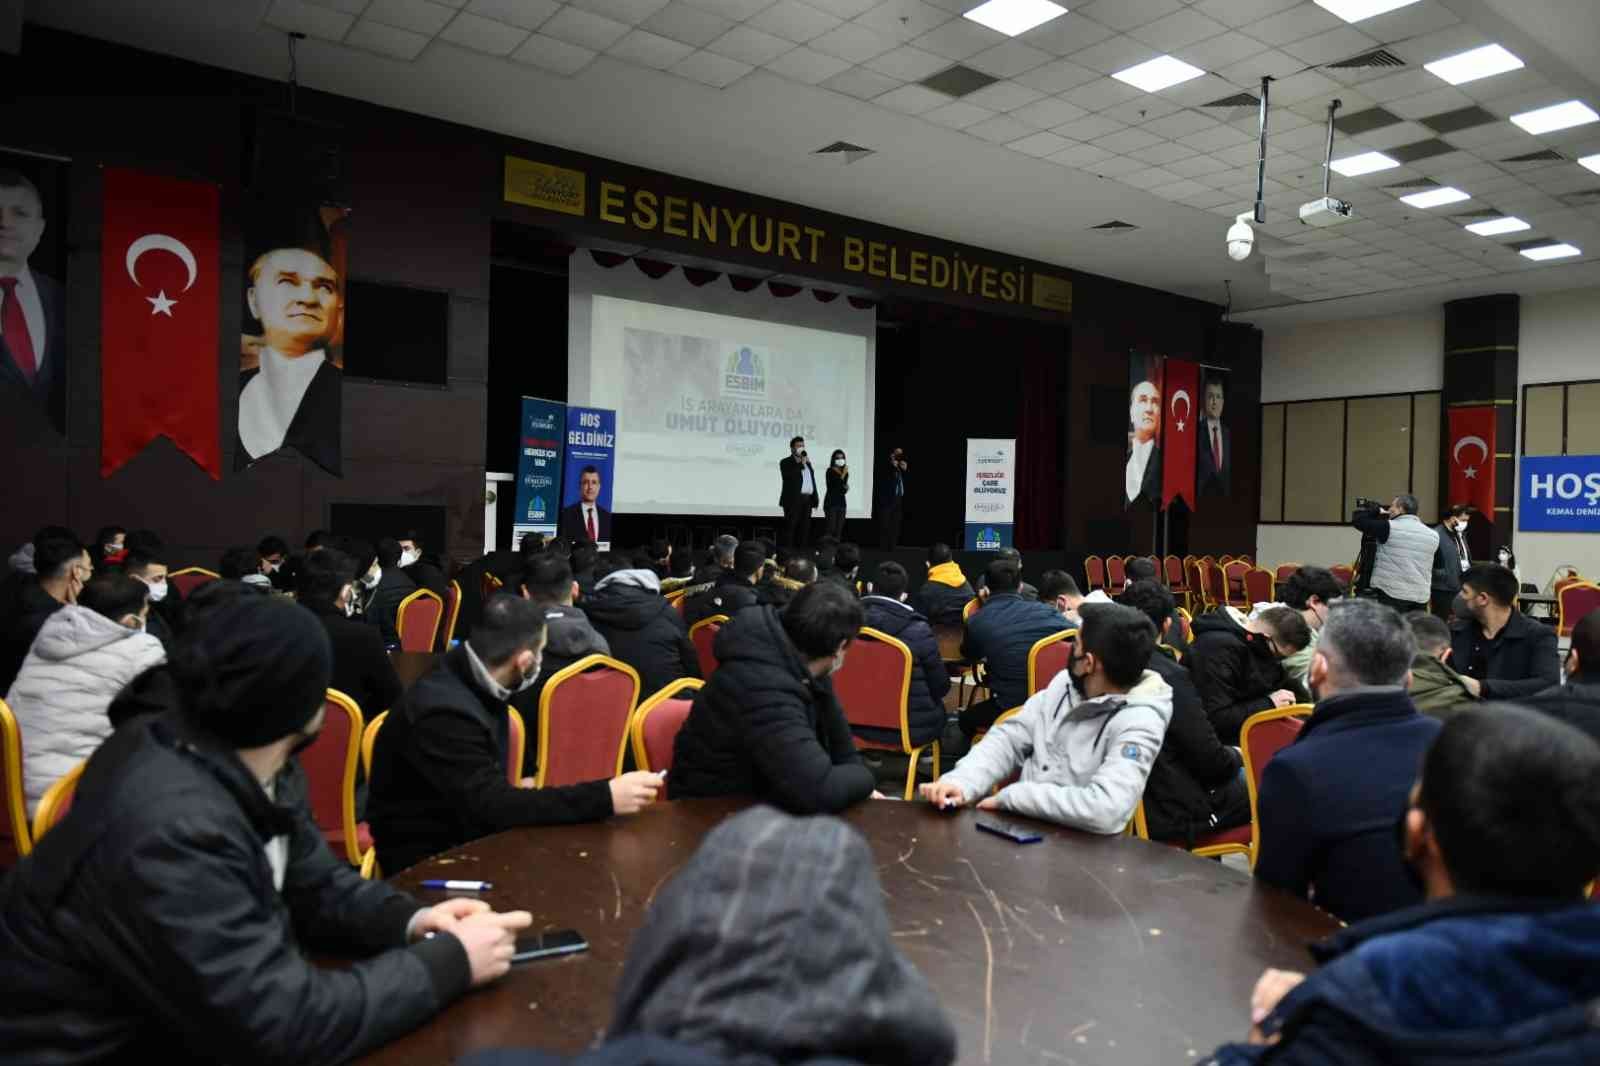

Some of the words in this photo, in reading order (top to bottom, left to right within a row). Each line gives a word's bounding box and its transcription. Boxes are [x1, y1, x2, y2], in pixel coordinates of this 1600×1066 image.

[600, 181, 826, 265] ESENYURT
[843, 235, 1026, 304] BELEDİYESİ
[580, 412, 601, 428] HOŞ
[666, 412, 719, 432] UMUT
[725, 416, 817, 441] OLUYORUZ
[568, 430, 614, 448] GELDİNİZ
[1531, 472, 1600, 506] HOŞ
[1546, 507, 1575, 516] KEMAL
